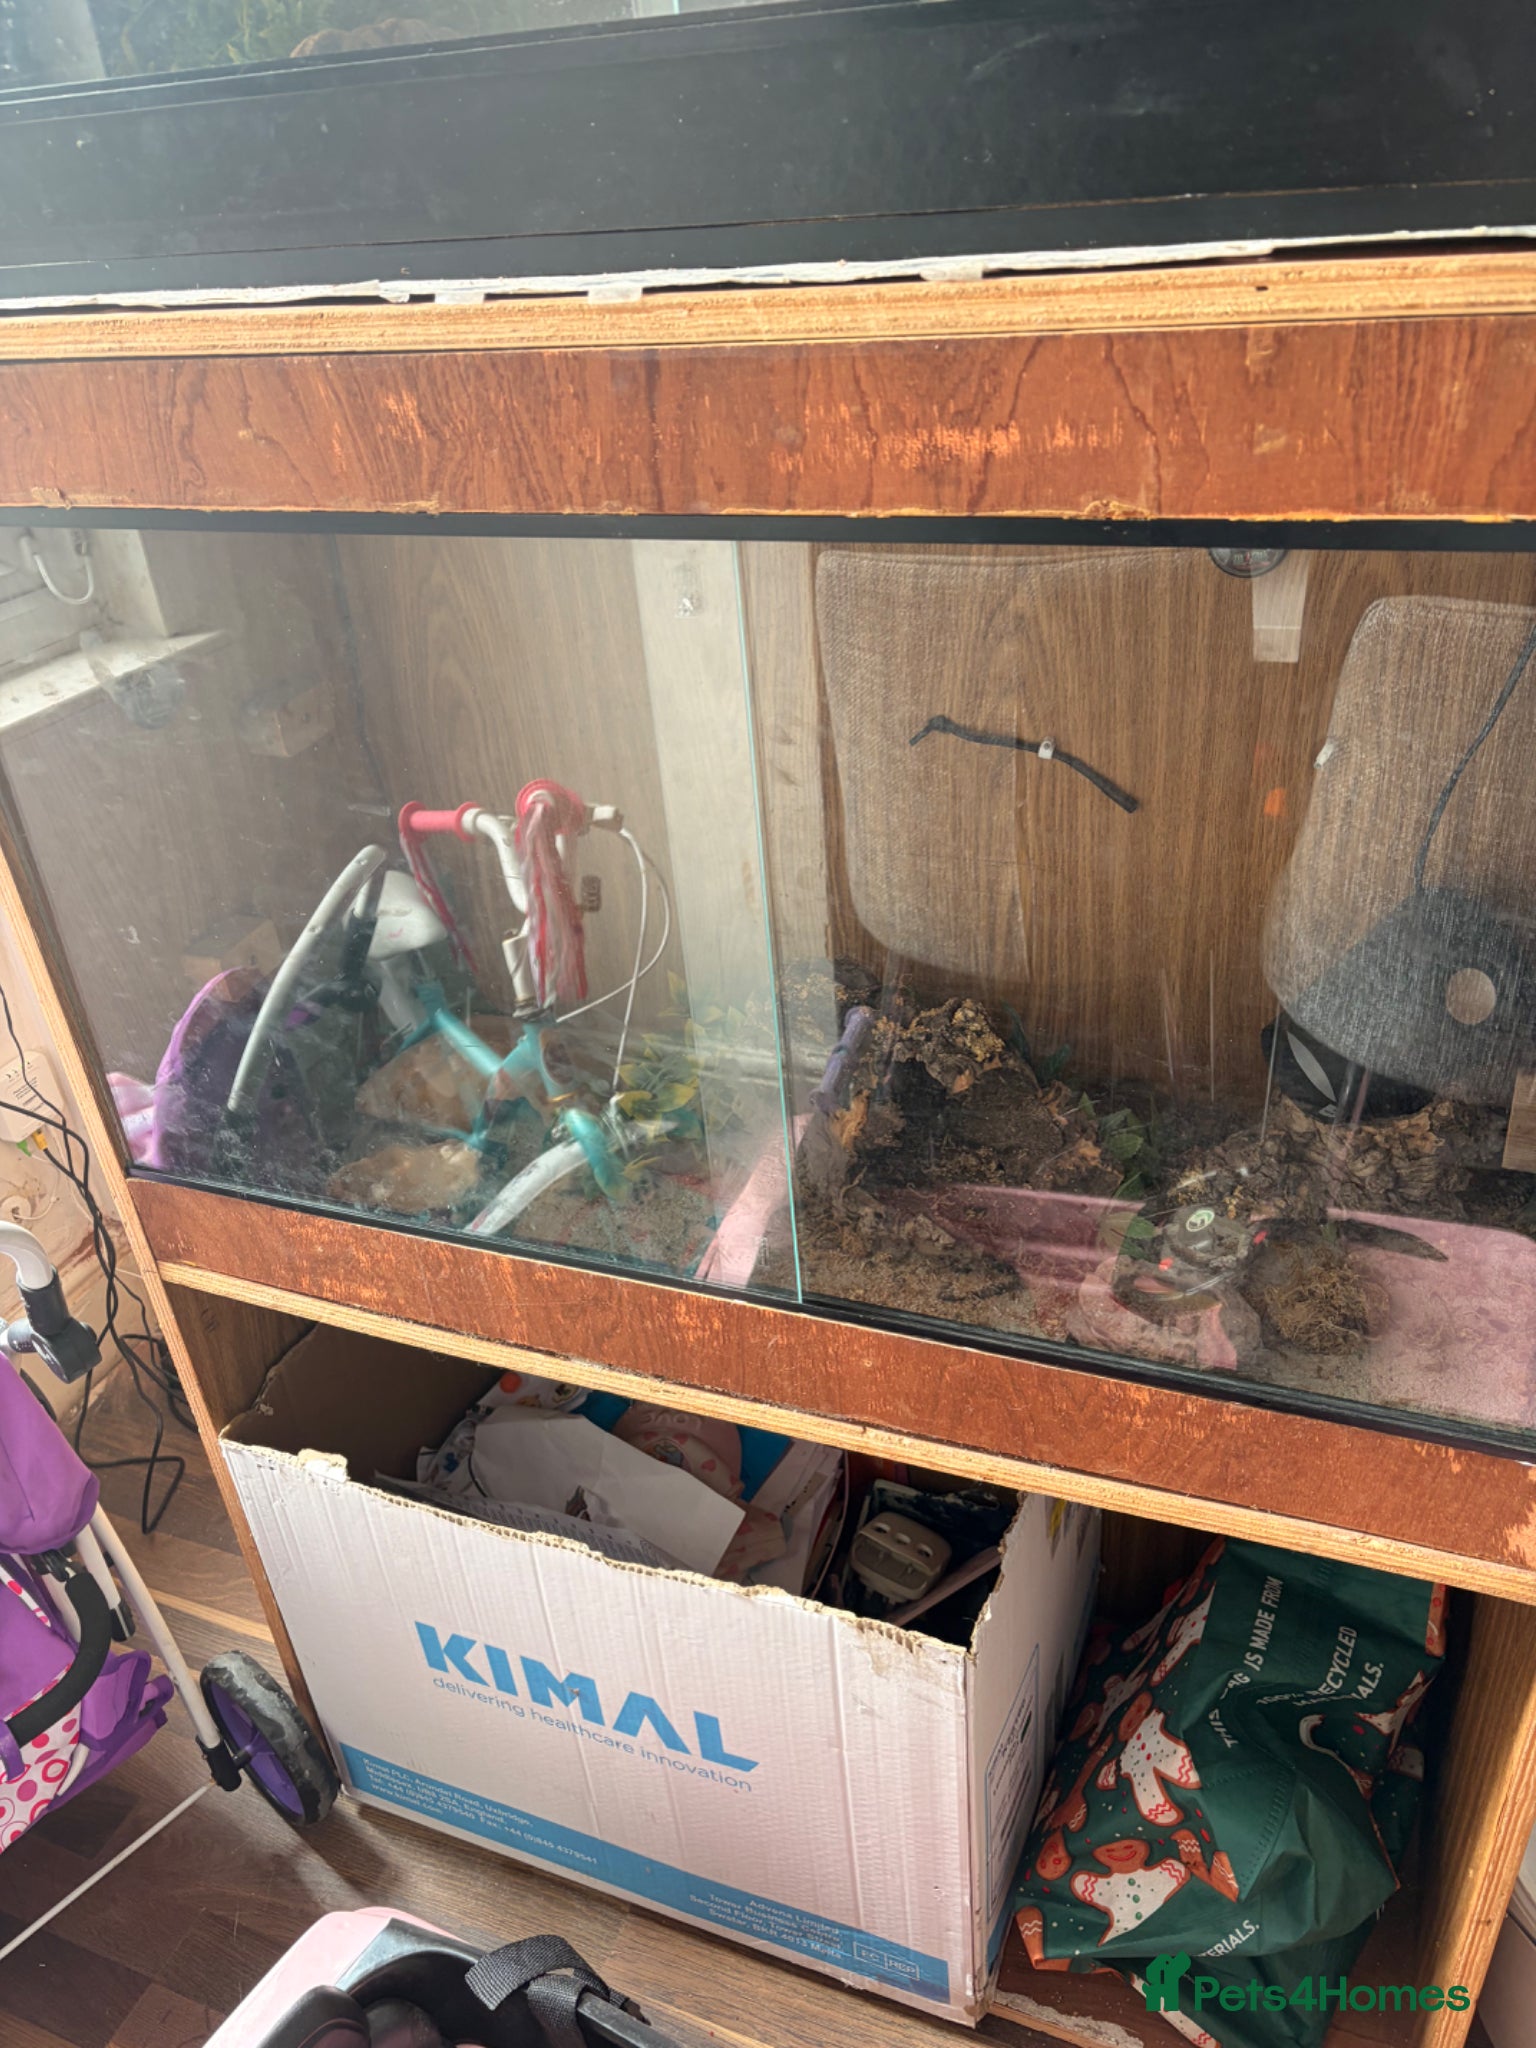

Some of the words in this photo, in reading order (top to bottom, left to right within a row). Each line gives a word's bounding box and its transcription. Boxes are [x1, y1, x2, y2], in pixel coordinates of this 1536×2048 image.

[1261, 1576, 1283, 1609] FROM
[1250, 1609, 1275, 1651] MADE
[1243, 1651, 1265, 1672] IS
[415, 1621, 760, 1773] KIMAL
[1219, 1672, 1251, 1700] AG
[432, 1676, 525, 1718] delivering
[530, 1707, 635, 1755] healthcare
[640, 1746, 752, 1792] innovation
[689, 1893, 732, 1914] Second
[769, 1921, 803, 1938] Tower
[709, 1893, 742, 1910] Tower
[744, 1905, 798, 1929] Business
[749, 1900, 793, 1920] Advena
[810, 1942, 842, 1960] Malta
[1192, 1919, 1260, 1957] ERIALS.
